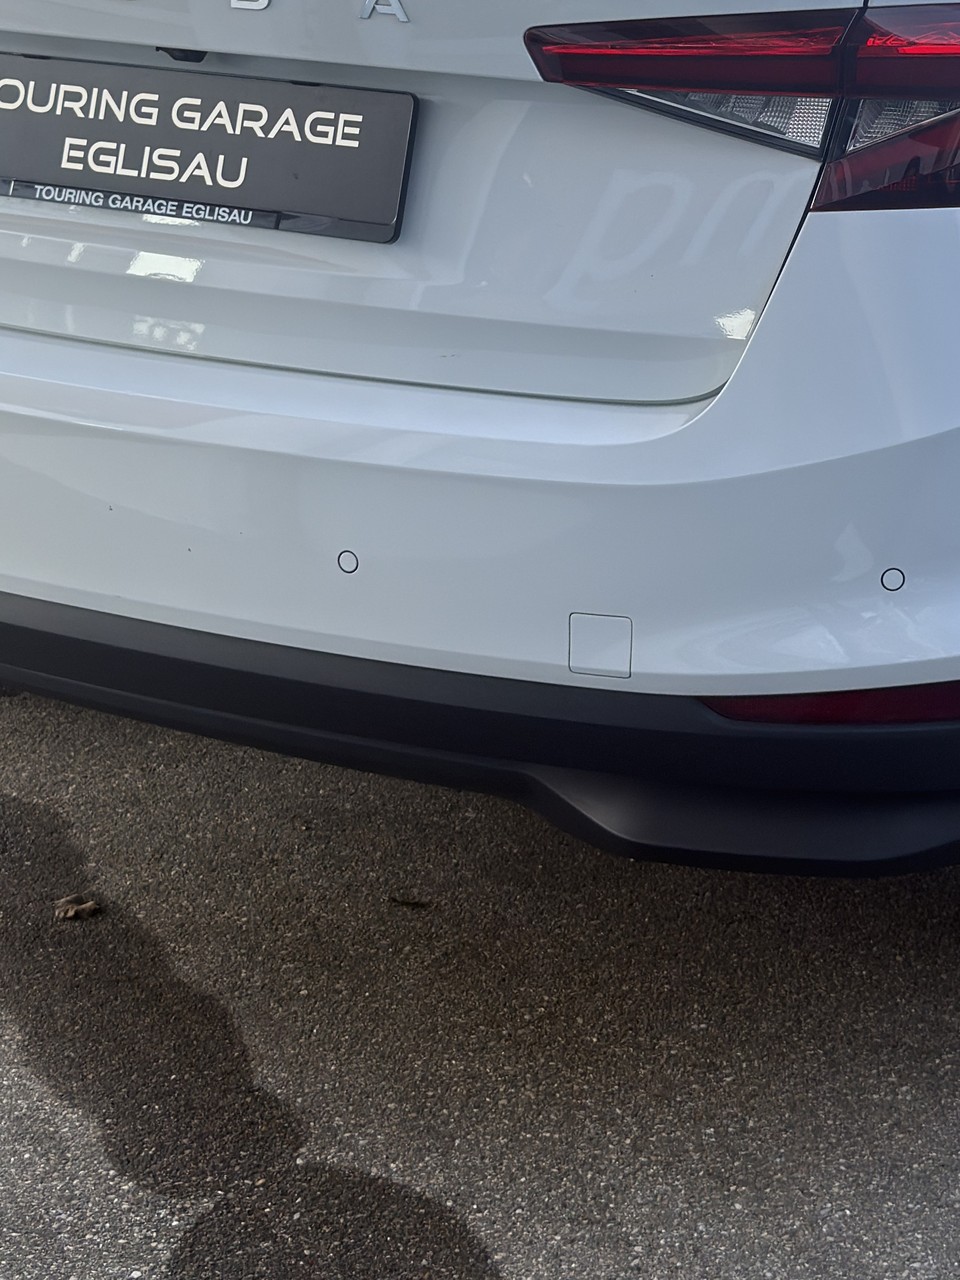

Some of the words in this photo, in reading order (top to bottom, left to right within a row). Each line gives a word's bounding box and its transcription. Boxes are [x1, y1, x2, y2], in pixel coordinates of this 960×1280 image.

[171, 97, 364, 148] GARAGE
[60, 136, 249, 189] EGLISAU
[34, 184, 104, 207] TOURING
[108, 193, 179, 216] GARAGE
[181, 203, 253, 225] EGLISAU
